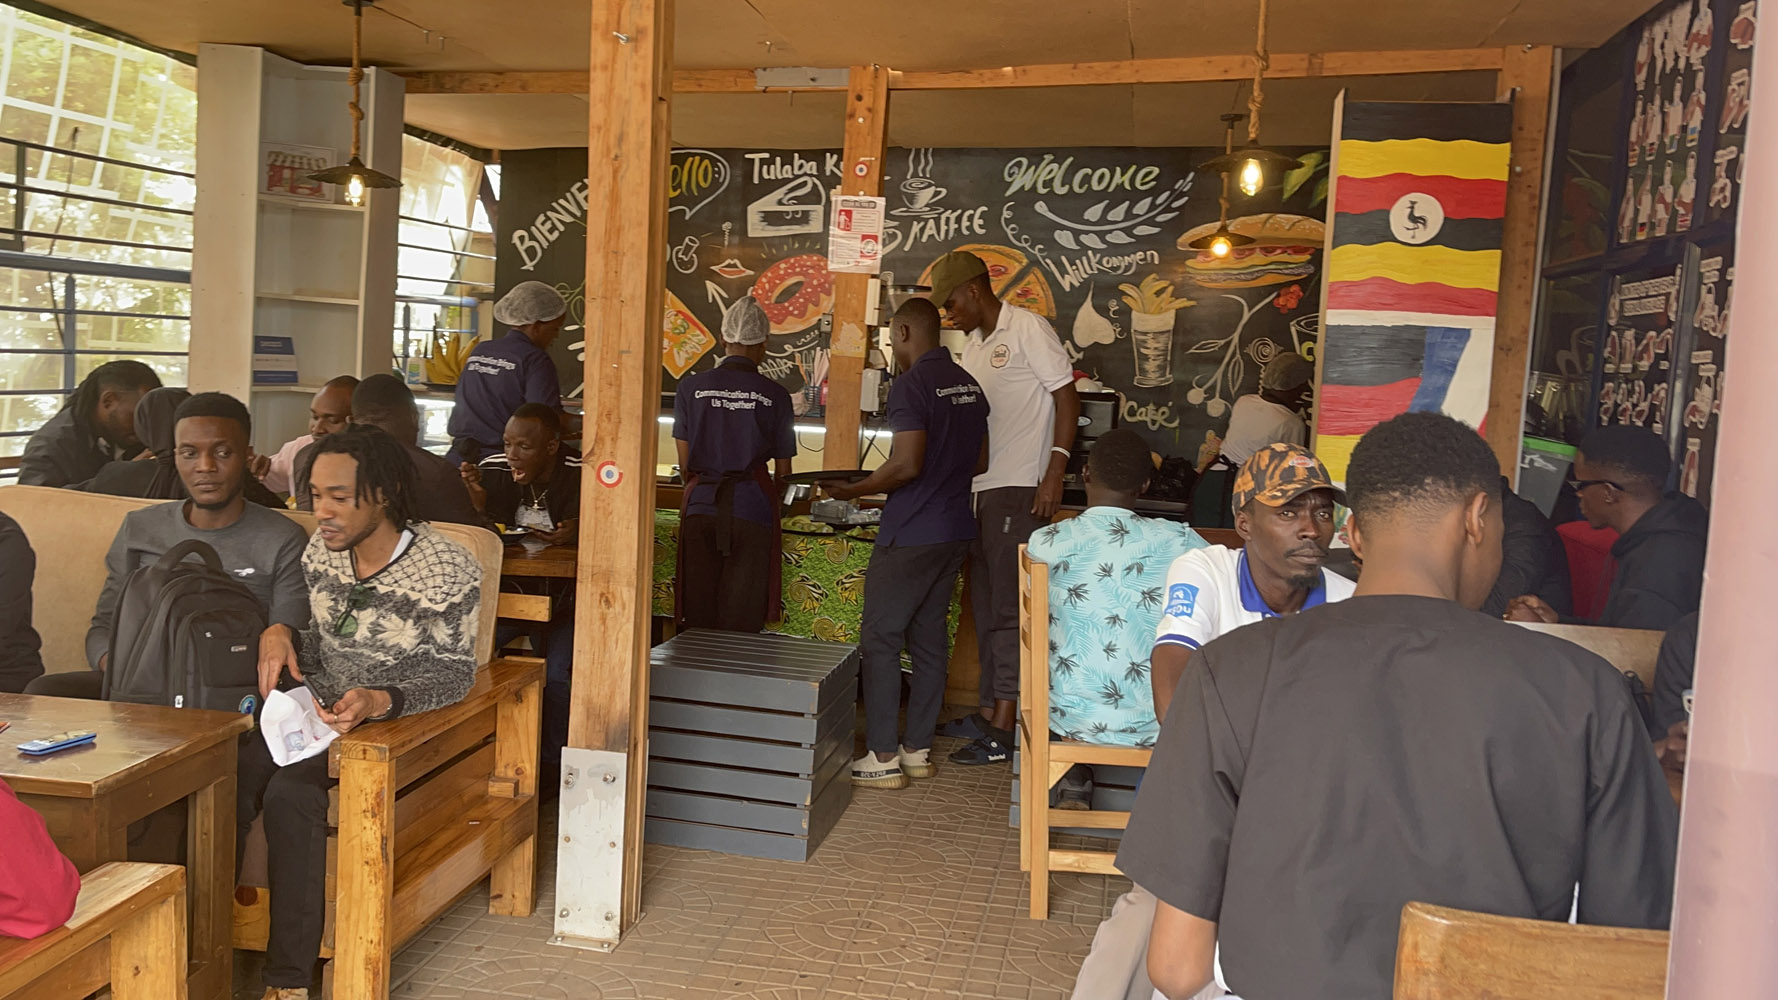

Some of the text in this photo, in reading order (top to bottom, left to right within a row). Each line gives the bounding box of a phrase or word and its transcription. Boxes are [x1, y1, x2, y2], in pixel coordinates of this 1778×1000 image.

[668, 155, 713, 198] ello
[744, 152, 819, 184] Tulaba
[511, 178, 589, 271] BIENVE
[903, 205, 988, 251] KAFFEE
[694, 389, 773, 407] Communication Brings
[711, 399, 756, 410] Us Together!
